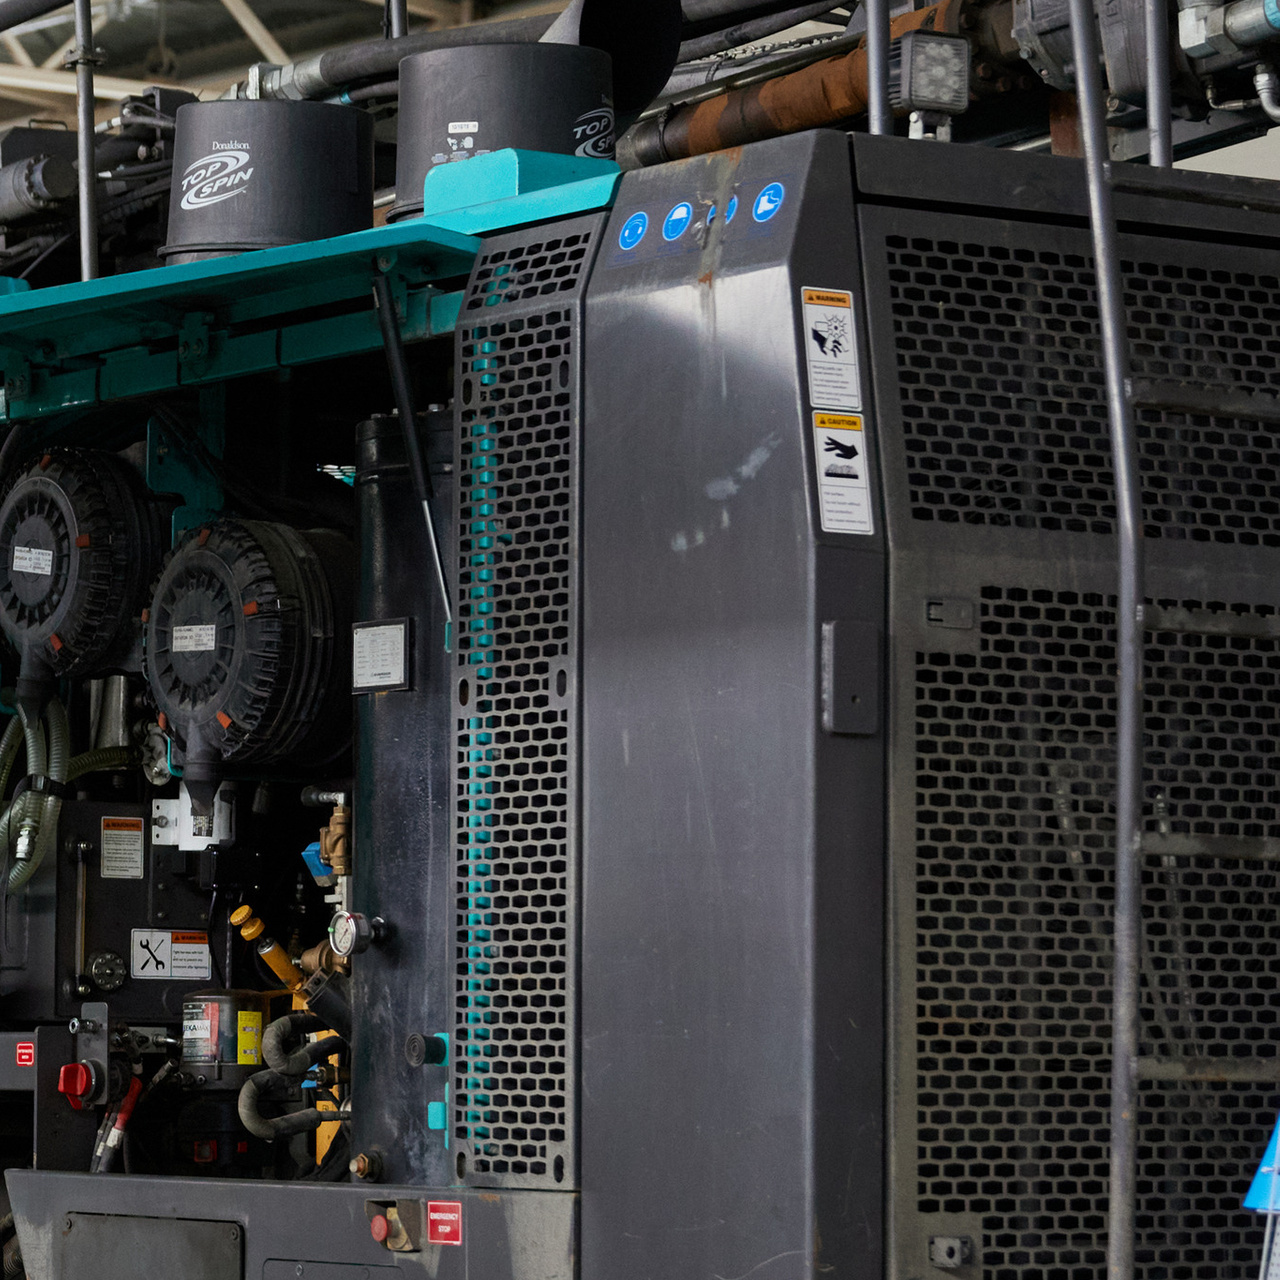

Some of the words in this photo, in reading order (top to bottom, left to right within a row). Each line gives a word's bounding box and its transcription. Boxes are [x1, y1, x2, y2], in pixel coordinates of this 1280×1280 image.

[573, 117, 608, 139] TOP
[212, 140, 250, 151] Donaldson
[181, 162, 222, 191] TOP
[200, 167, 254, 198] SPIN
[815, 294, 847, 303] WARNING
[827, 418, 858, 426] CAUTION
[430, 1212, 458, 1220] EMERGENCY
